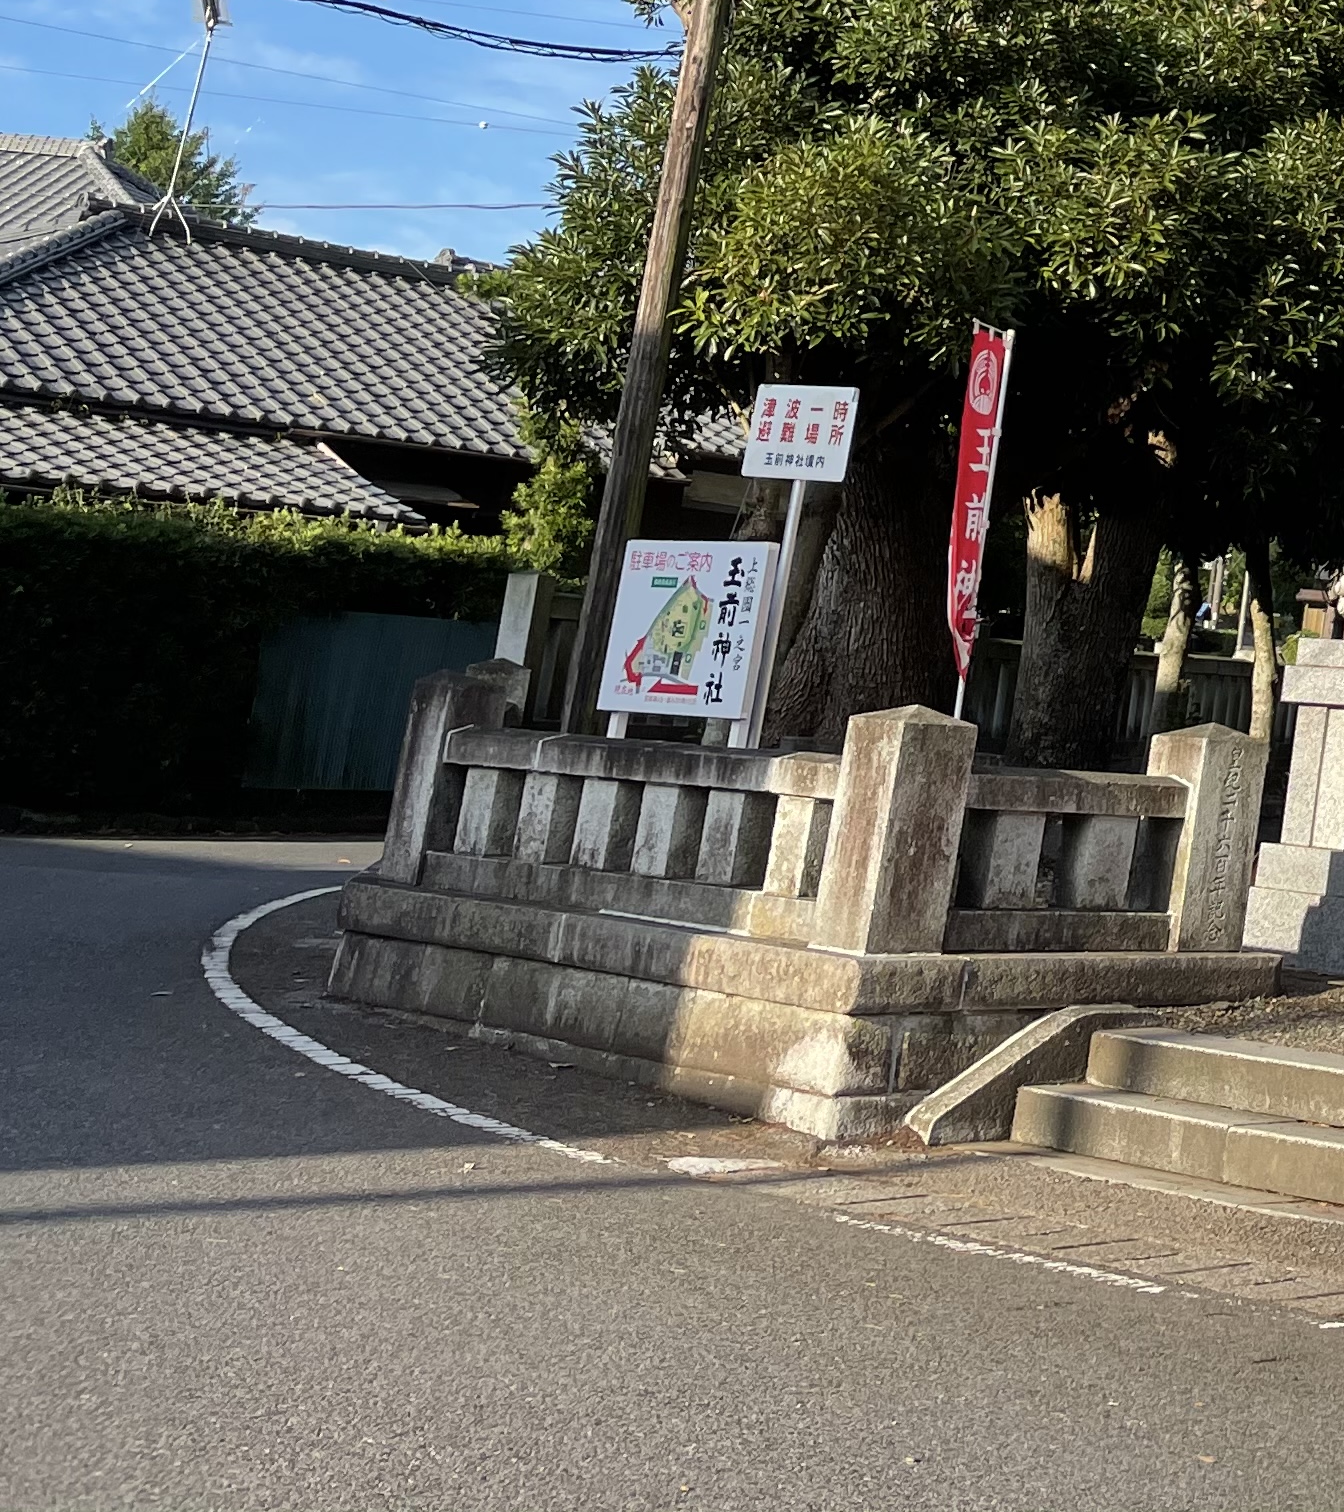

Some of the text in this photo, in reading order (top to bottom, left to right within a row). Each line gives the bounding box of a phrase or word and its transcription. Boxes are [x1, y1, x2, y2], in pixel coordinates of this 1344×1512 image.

[760, 397, 849, 423] 津波一時
[755, 420, 845, 447] 避難場所
[629, 550, 714, 573] 駐車場のご案内
[702, 556, 745, 706] 玉前神社
